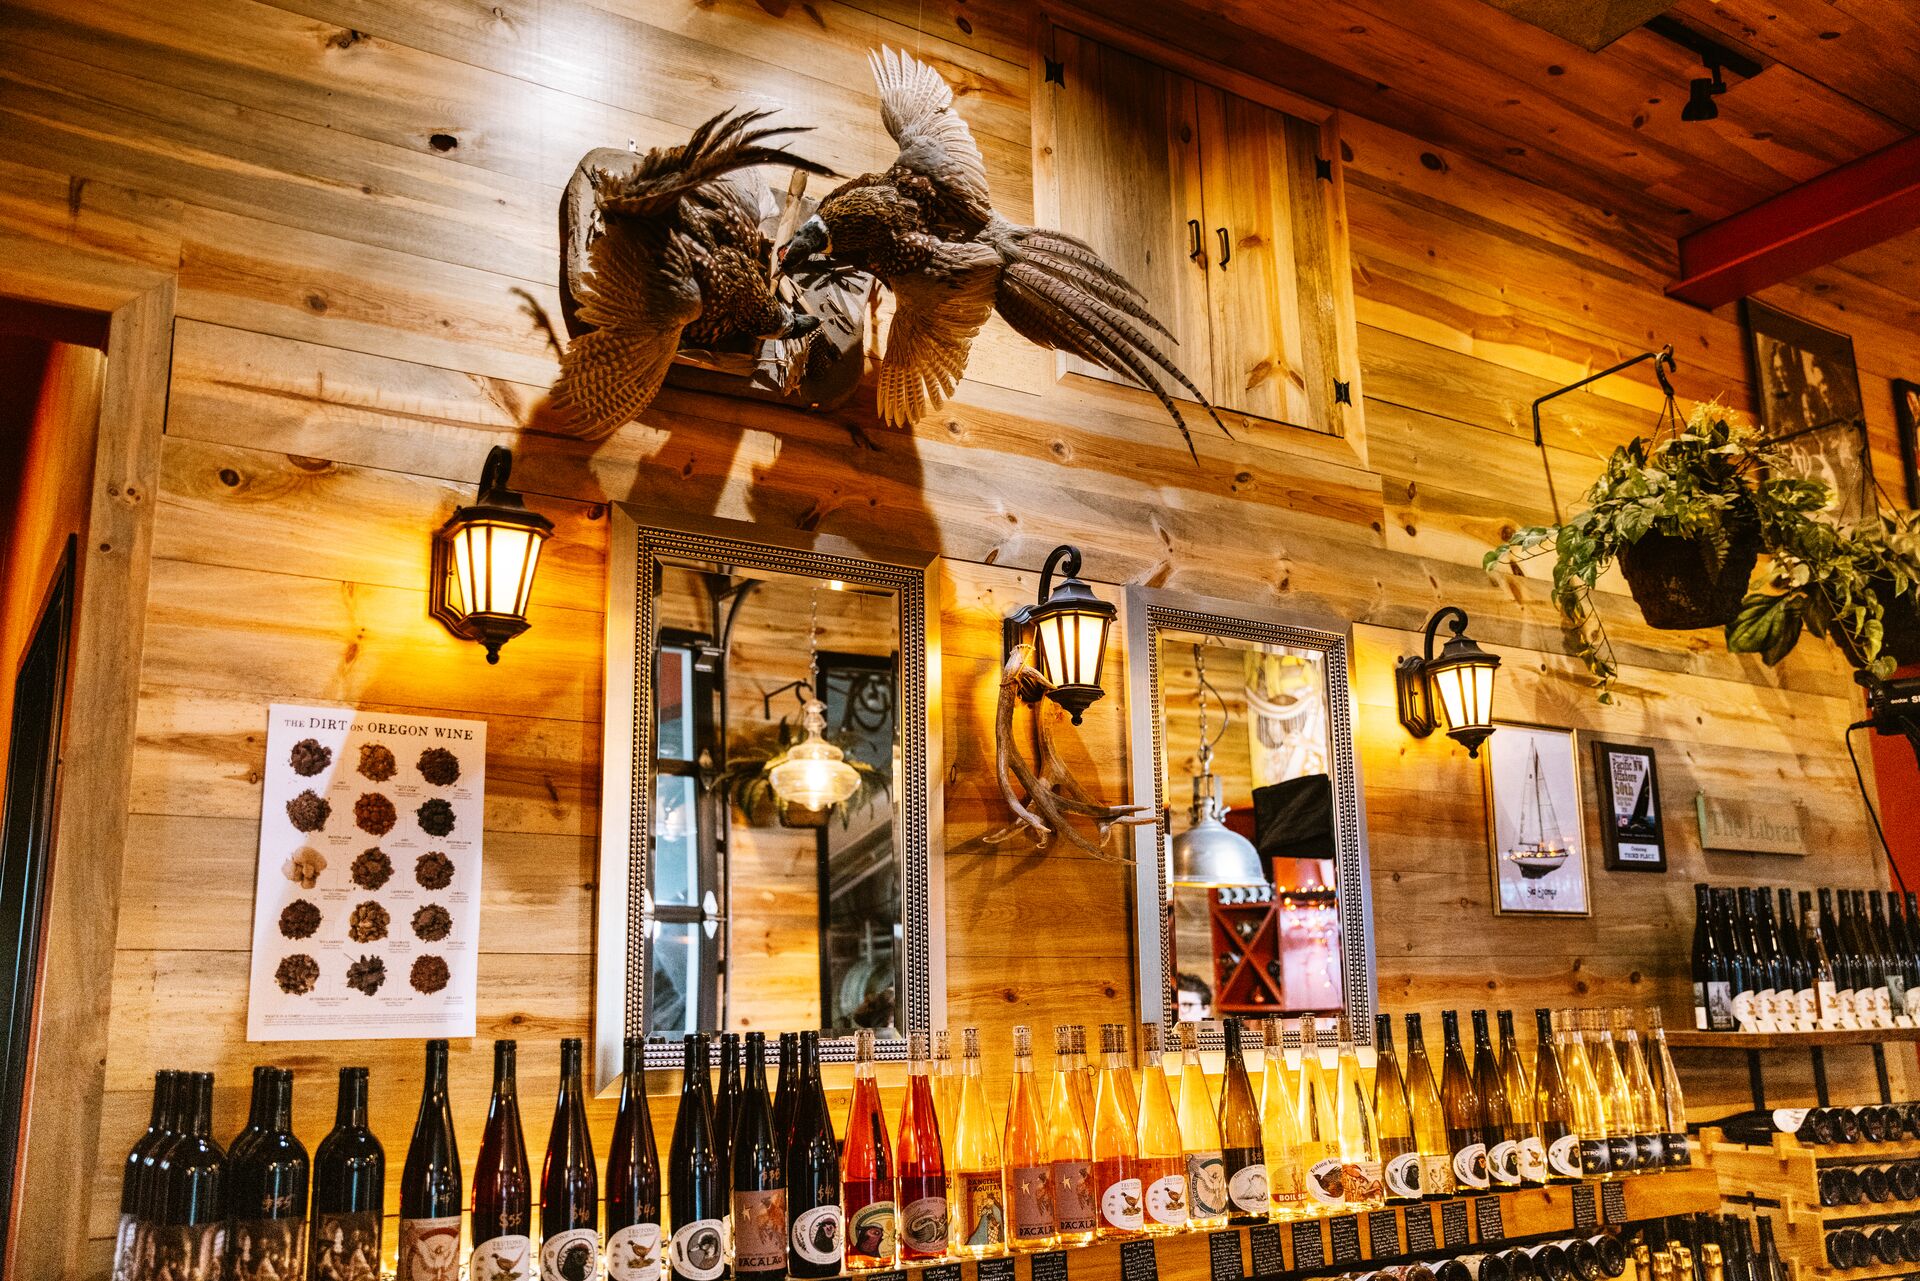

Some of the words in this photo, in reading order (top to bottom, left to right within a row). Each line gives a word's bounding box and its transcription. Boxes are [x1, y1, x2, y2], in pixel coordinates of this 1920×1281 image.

[285, 719, 305, 728] THE
[310, 717, 347, 731] DIRT
[350, 724, 364, 732] ON
[368, 722, 428, 737] OREGON
[434, 727, 473, 741] WINE
[1615, 781, 1634, 796] 50th
[1279, 1194, 1297, 1202] BOIL
